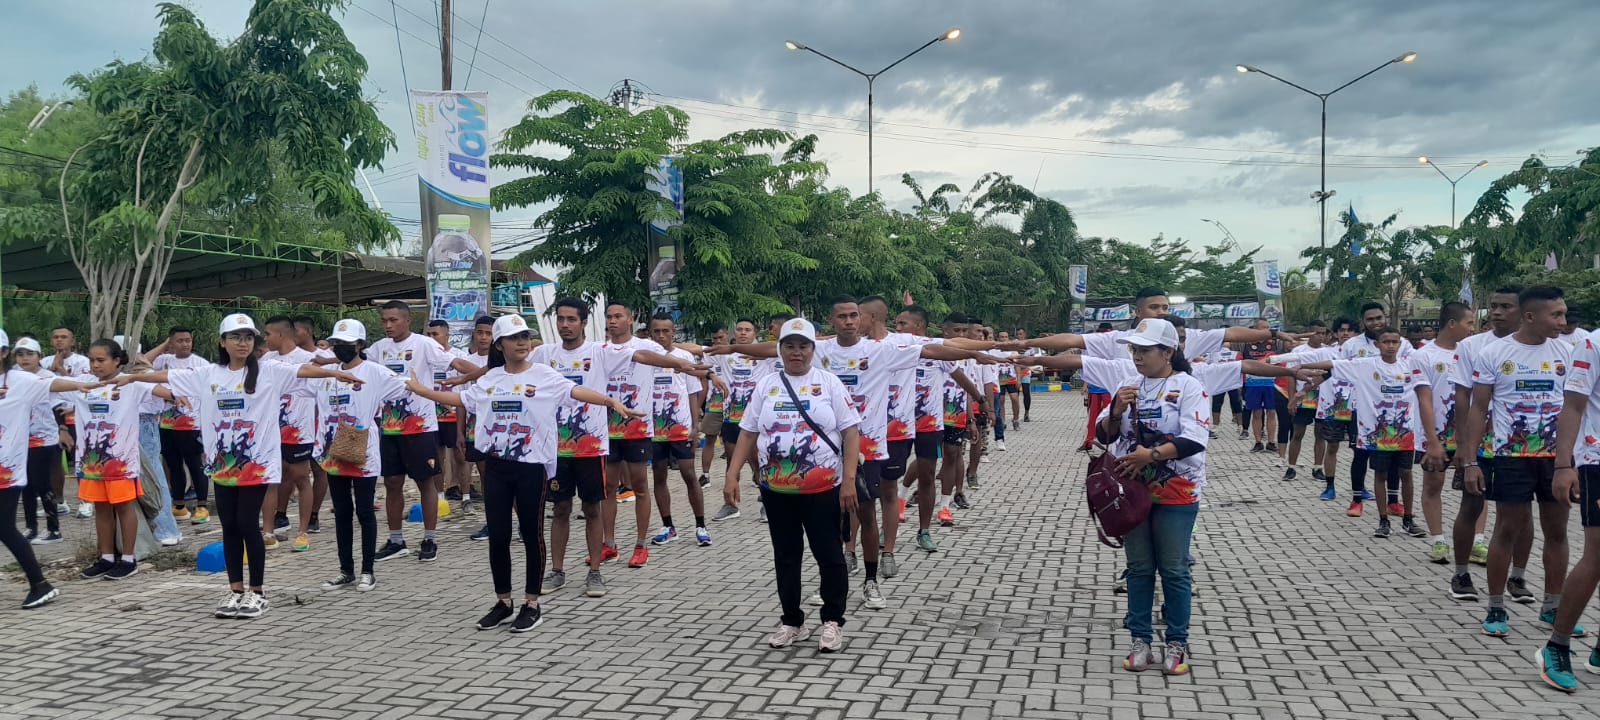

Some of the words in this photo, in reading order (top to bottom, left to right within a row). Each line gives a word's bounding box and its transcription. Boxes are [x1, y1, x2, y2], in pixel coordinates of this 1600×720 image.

[449, 96, 486, 183] flow
[433, 295, 480, 320] flow
[1102, 307, 1128, 319] flow
[1231, 304, 1258, 317] flow
